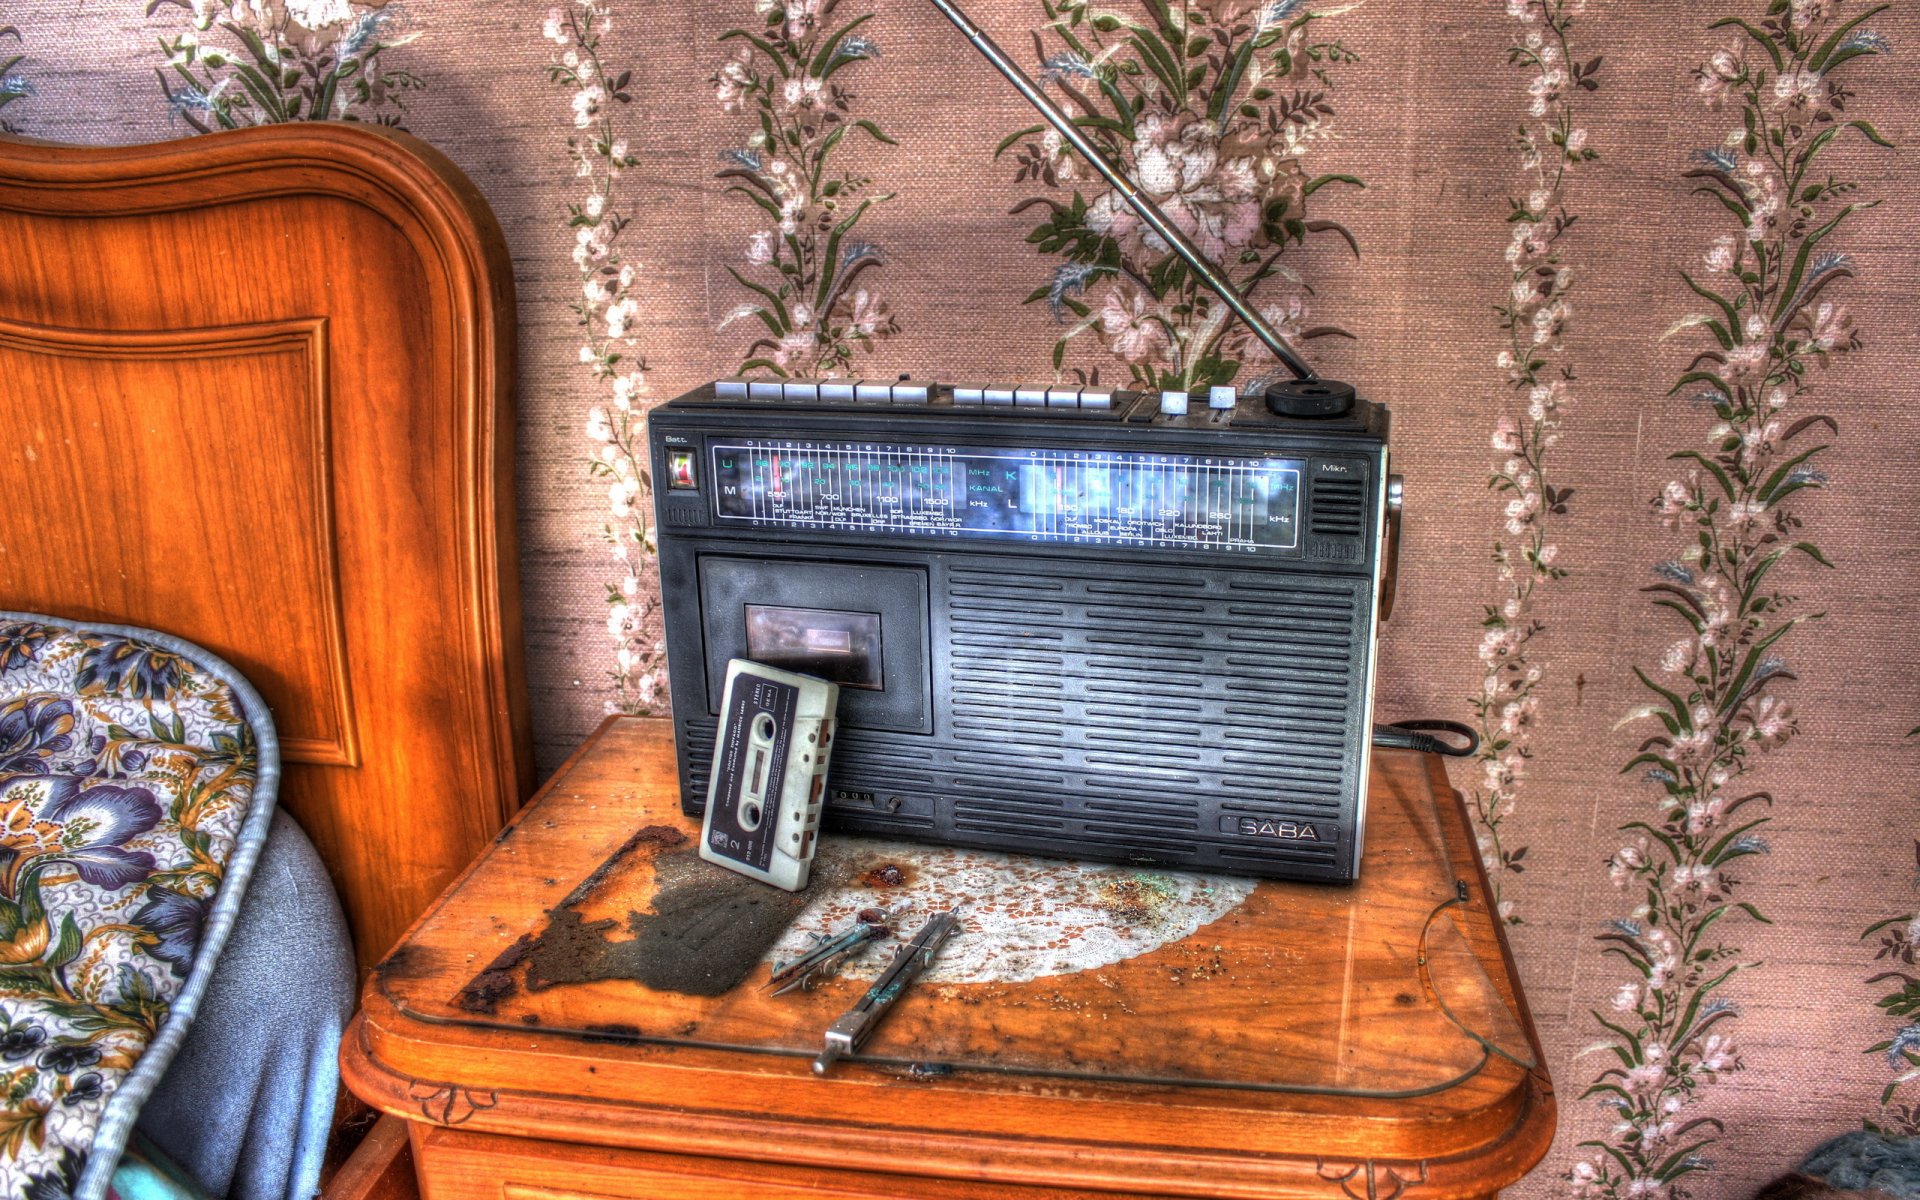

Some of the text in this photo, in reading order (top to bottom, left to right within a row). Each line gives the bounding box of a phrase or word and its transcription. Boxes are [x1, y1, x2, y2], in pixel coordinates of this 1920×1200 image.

[722, 460, 732, 468] U
[1322, 464, 1347, 472] Mikr.
[1006, 471, 1017, 480] K
[724, 486, 736, 495] M
[1008, 499, 1017, 508] L
[1241, 820, 1318, 840] SABA
[730, 839, 740, 850] 2
